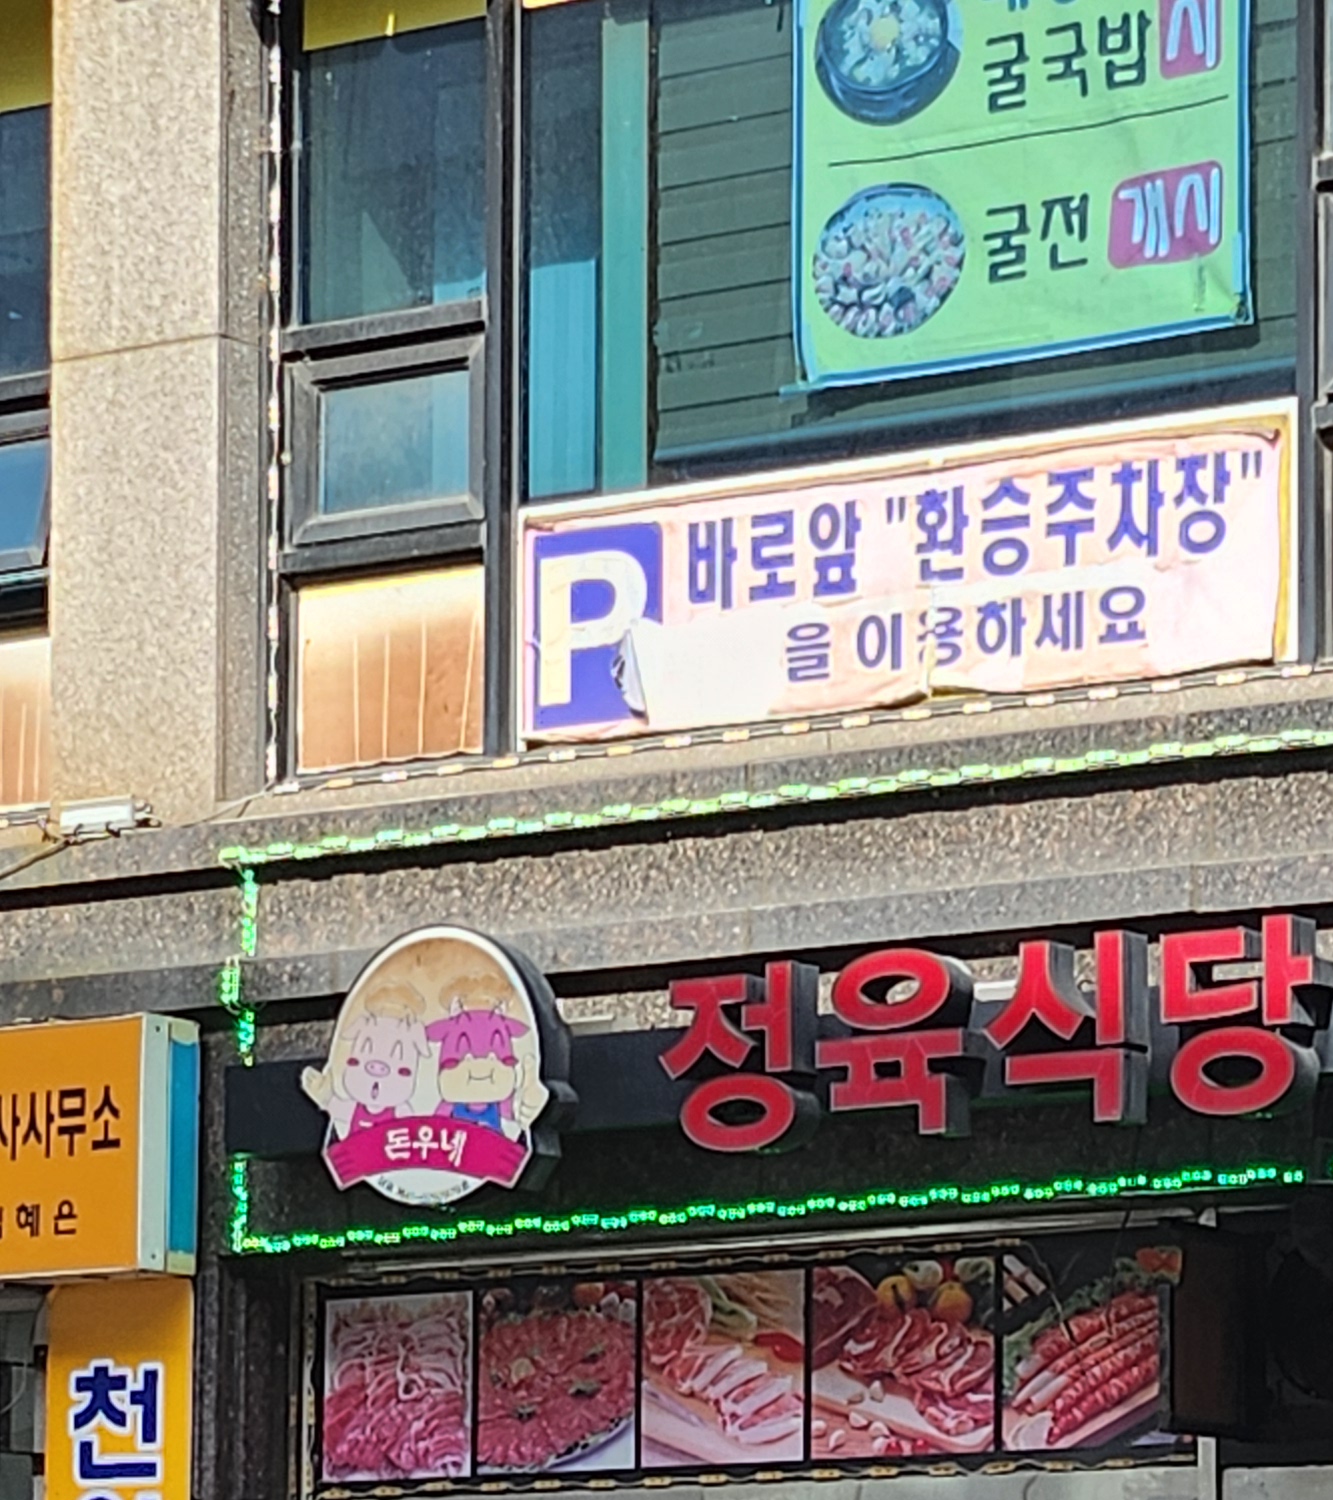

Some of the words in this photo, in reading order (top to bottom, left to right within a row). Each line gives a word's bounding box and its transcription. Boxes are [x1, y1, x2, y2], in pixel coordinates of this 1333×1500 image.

[983, 10, 1151, 113] 굴국밥
[983, 193, 1089, 284] 굴전
[1118, 167, 1220, 258] 개시
[686, 502, 860, 609] 바로앞
[884, 450, 1264, 581] "환승주차장"
[786, 621, 831, 682] 을
[856, 585, 1147, 670] 이용하세요
[658, 914, 1320, 1153] 정육식당
[383, 1125, 468, 1168] 돈우네
[0, 1200, 78, 1241] 예은
